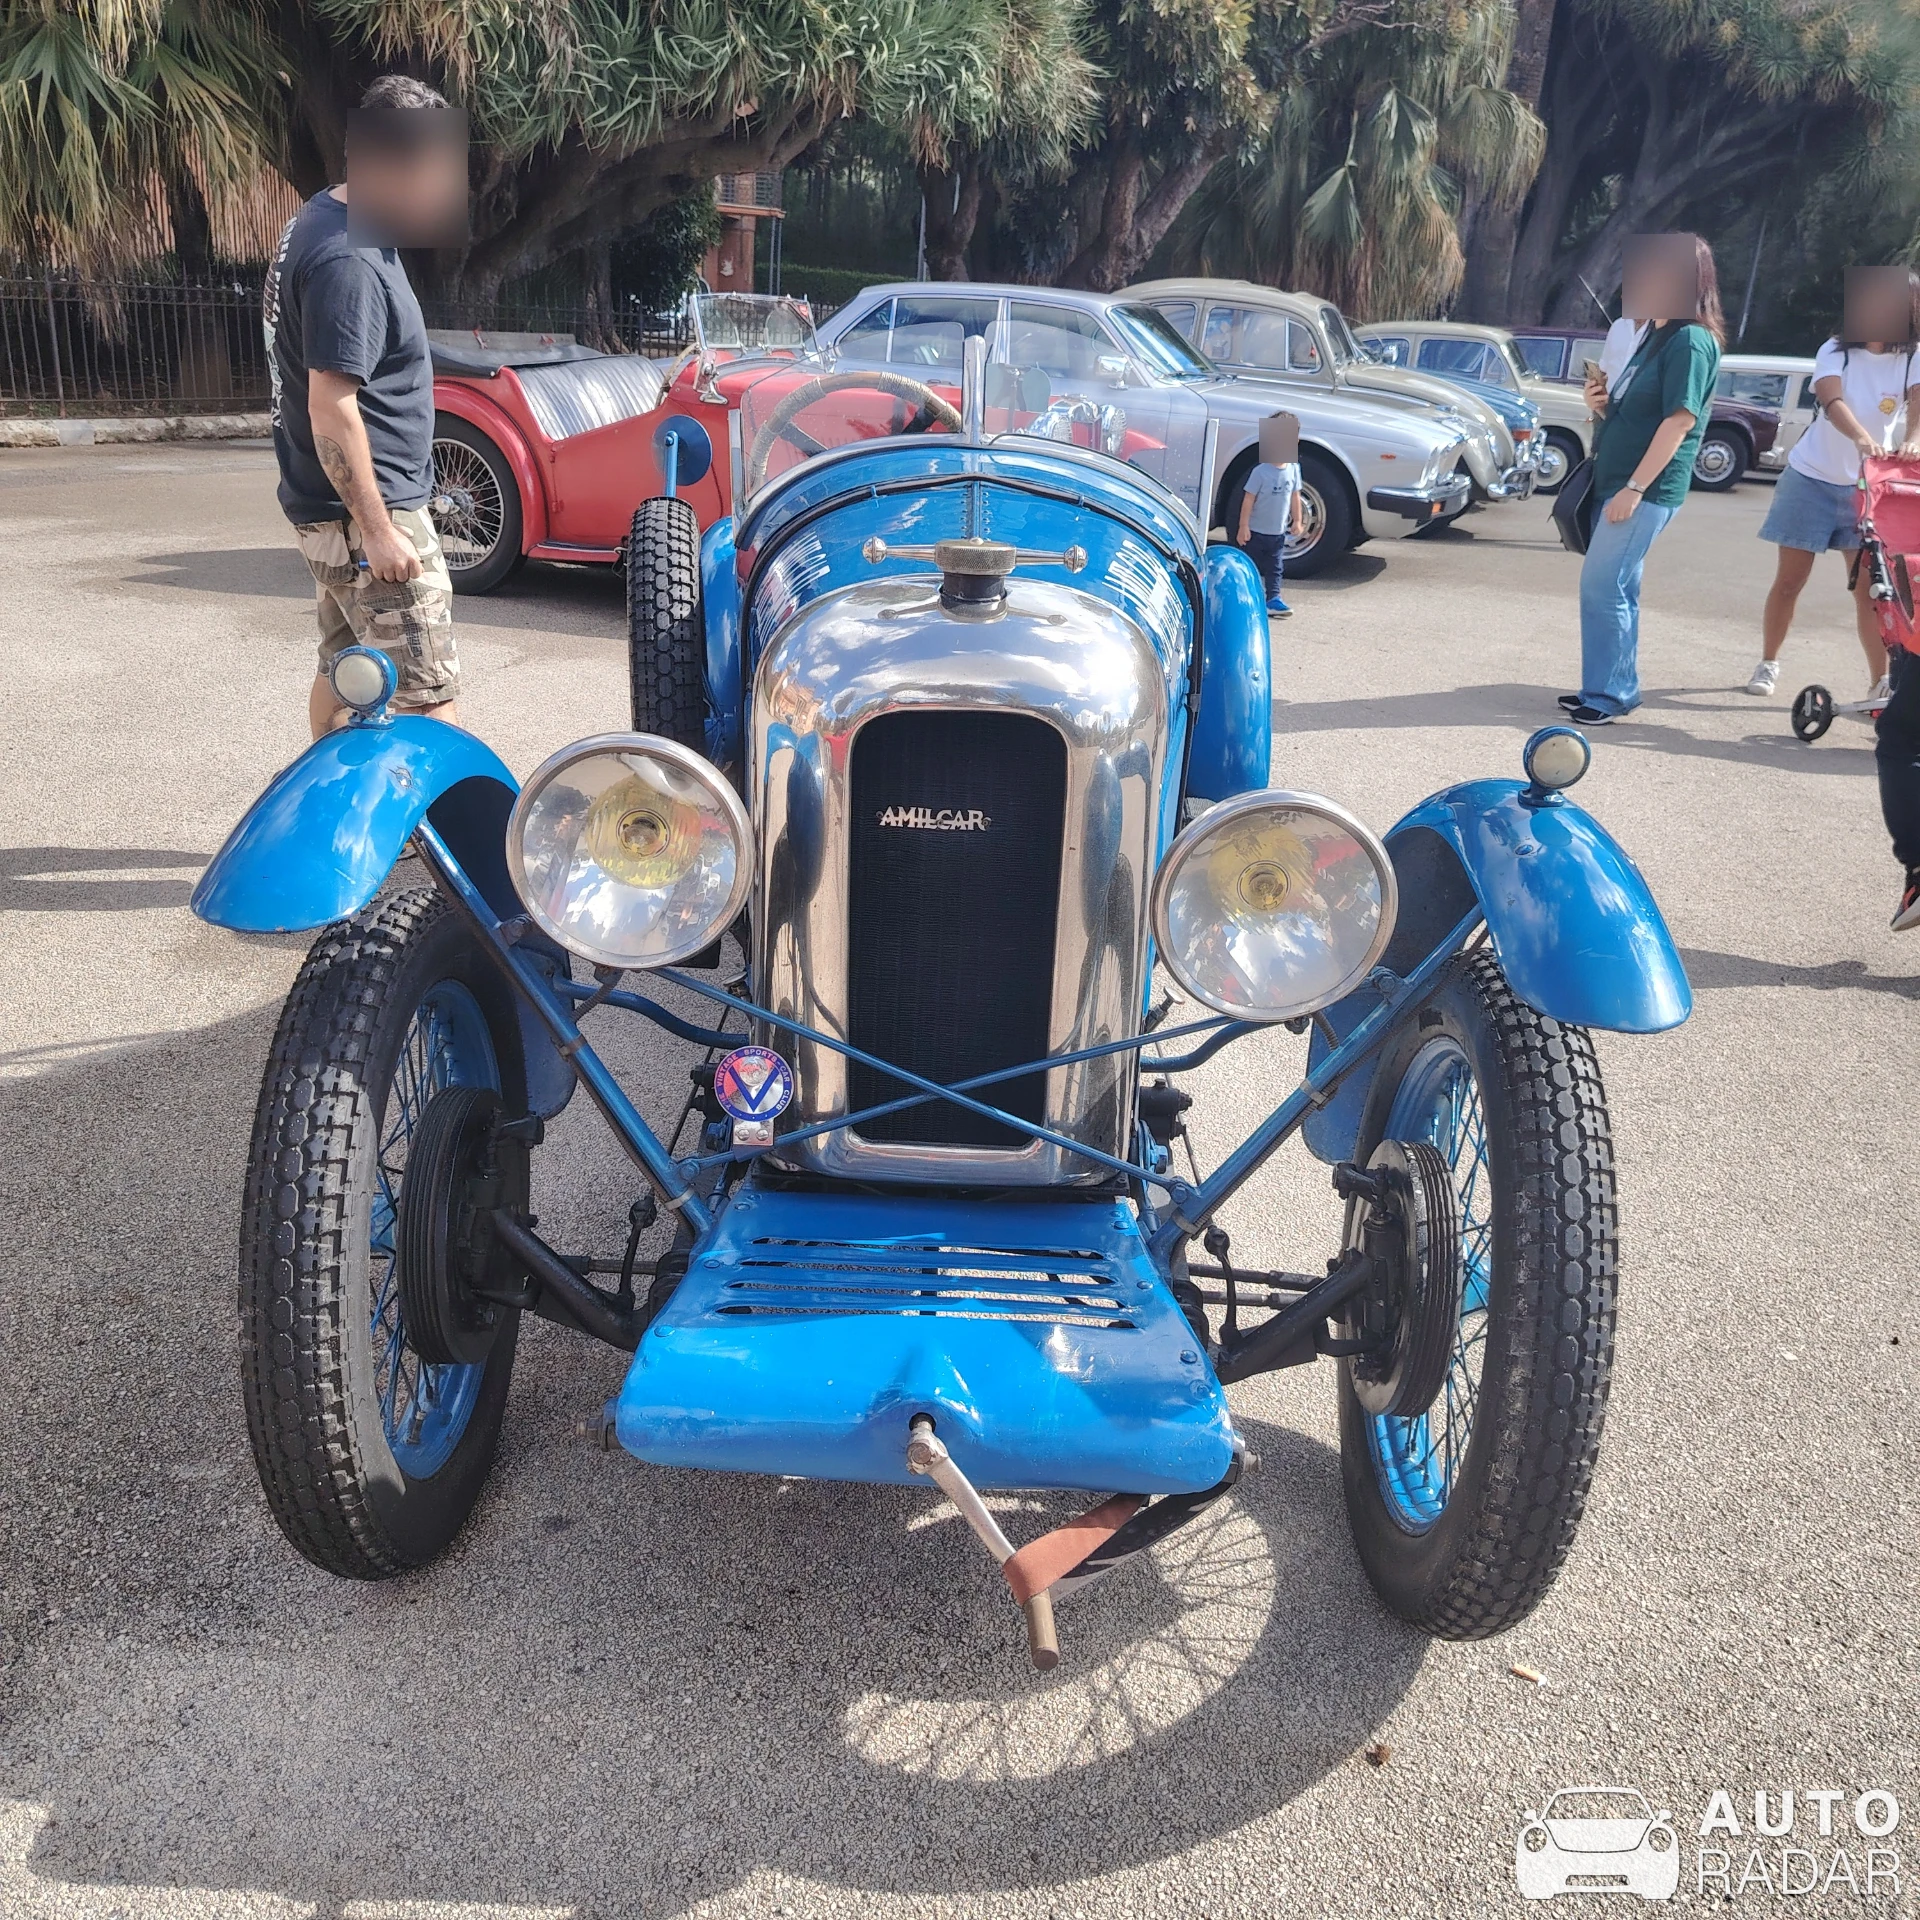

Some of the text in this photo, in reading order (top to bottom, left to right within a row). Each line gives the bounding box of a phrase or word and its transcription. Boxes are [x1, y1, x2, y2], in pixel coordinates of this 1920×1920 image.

[880, 806, 986, 831] AMILCAR
[717, 1053, 739, 1087] VINTAGE
[776, 1089, 790, 1111] CLUB
